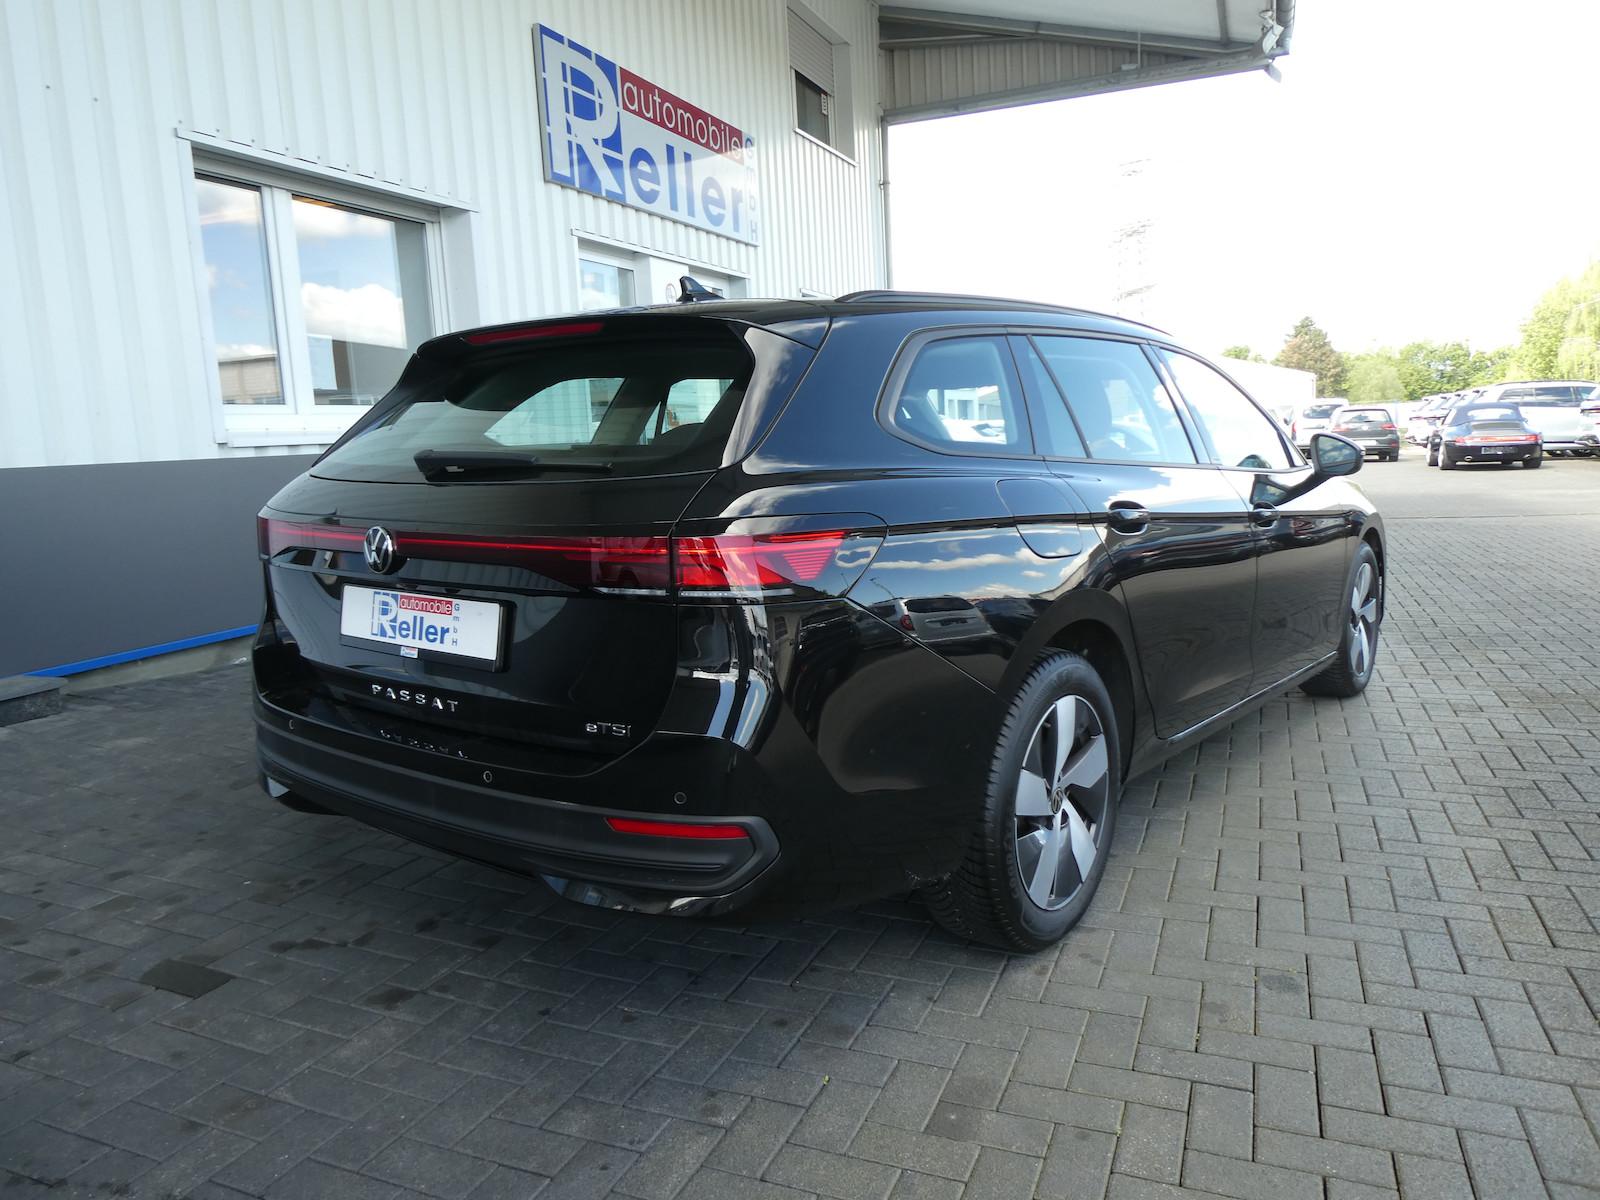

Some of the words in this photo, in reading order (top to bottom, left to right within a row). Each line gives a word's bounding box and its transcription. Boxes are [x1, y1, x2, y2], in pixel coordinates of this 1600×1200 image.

[623, 81, 743, 159] automobile
[400, 597, 452, 615] automobile
[371, 684, 459, 712] PASSAT
